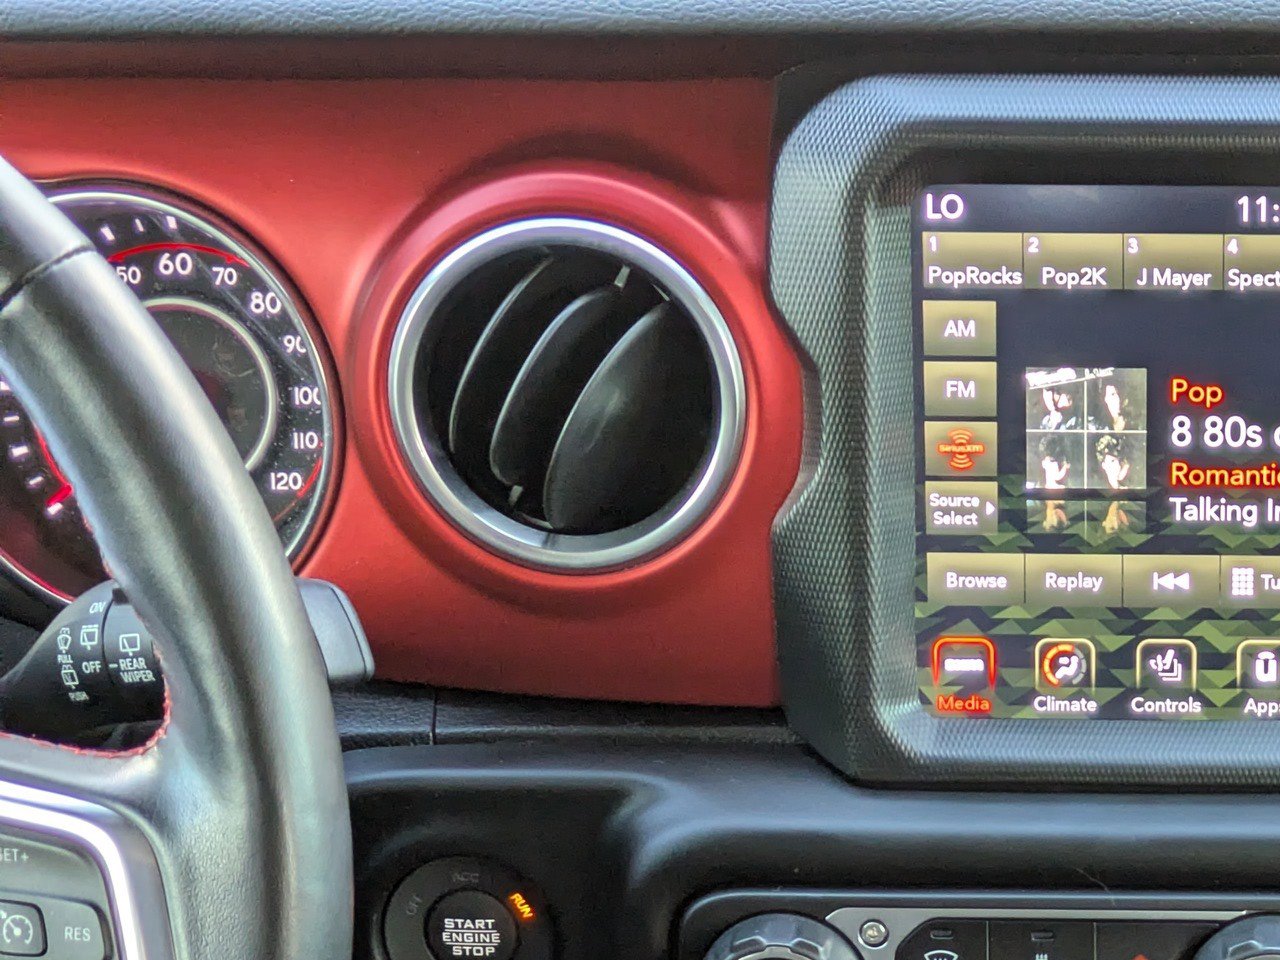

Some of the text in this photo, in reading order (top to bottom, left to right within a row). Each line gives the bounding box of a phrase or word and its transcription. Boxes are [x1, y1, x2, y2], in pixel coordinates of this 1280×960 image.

[926, 194, 964, 220] LO
[929, 237, 937, 251] 1
[1028, 238, 1039, 253] 2
[1128, 238, 1138, 253] 3
[1227, 239, 1239, 254] 4
[158, 252, 193, 275] 60
[116, 265, 142, 285] 50
[211, 266, 238, 285] 70
[928, 266, 1023, 288] PopRocks
[1042, 267, 1107, 289] Pop2K
[1137, 268, 1212, 290] J Mayer
[250, 291, 282, 314] 80
[944, 320, 976, 337] AM
[946, 381, 976, 398] FM
[1171, 378, 1223, 407] Pop
[1171, 415, 1192, 447] 8
[1203, 416, 1263, 448] 80s
[293, 431, 318, 450] 110
[270, 472, 302, 491] 120
[929, 493, 980, 509] Source
[933, 511, 978, 526] Select
[1170, 497, 1257, 527] Talking
[946, 572, 1007, 589] Browse
[1046, 572, 1103, 592] Replay
[89, 602, 106, 614] ON
[81, 660, 102, 674] OFF
[118, 657, 148, 670] REAR
[120, 670, 156, 683] WIPER
[937, 695, 990, 711] Media
[1033, 695, 1097, 712] Climate
[1131, 697, 1202, 714] Controls
[508, 892, 534, 919] RUN
[444, 918, 496, 930] START
[64, 926, 91, 942] RES
[442, 932, 501, 943] ENGINE
[452, 946, 495, 957] STOP
